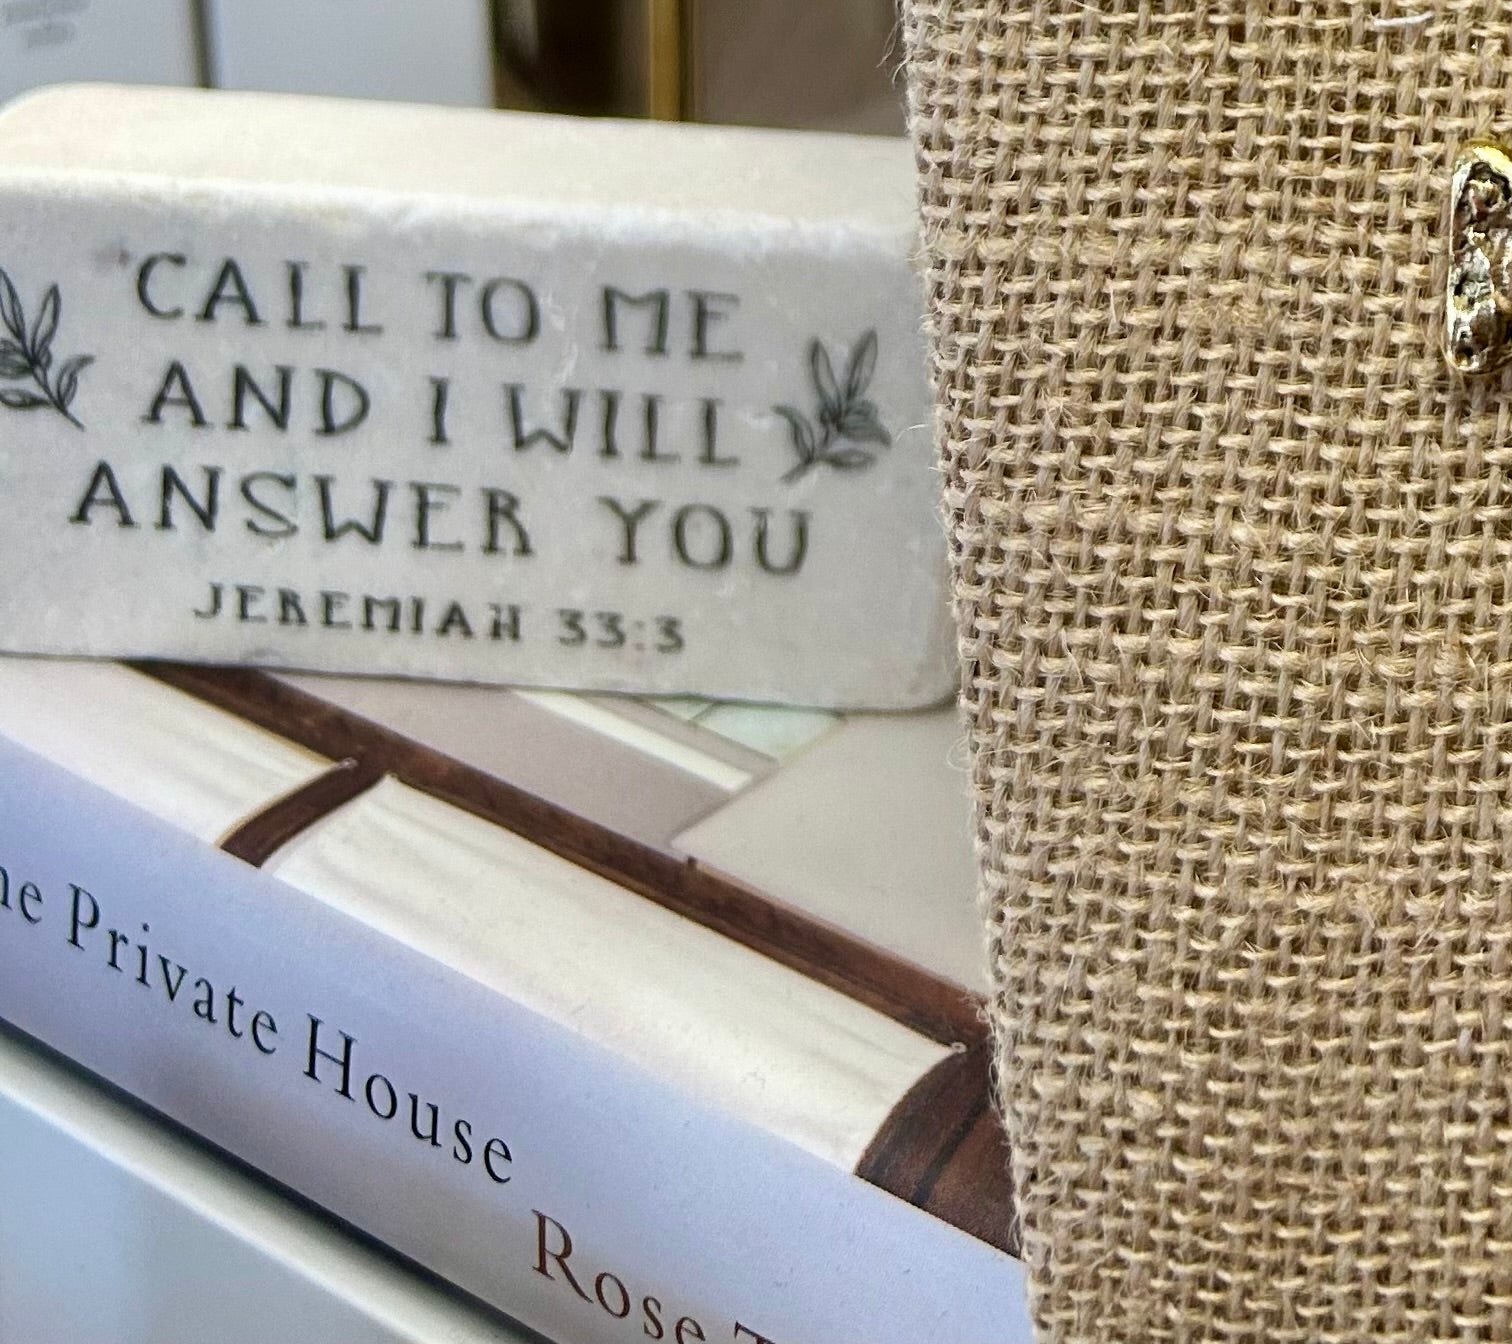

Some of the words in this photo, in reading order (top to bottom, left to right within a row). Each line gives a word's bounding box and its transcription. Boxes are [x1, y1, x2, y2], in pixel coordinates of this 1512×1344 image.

[135, 251, 385, 335] CALL
[424, 269, 543, 346] TO
[599, 285, 745, 364] ME
[140, 360, 372, 436] AND
[425, 376, 452, 447] I
[502, 382, 744, 468] WILL
[67, 459, 535, 558] ANSWER
[596, 494, 815, 577] YOU
[193, 581, 525, 643] JEREMIAH
[555, 608, 687, 654] 33:3
[65, 881, 280, 1056] Private
[301, 1013, 515, 1186] House
[530, 1207, 707, 1344] Rose
